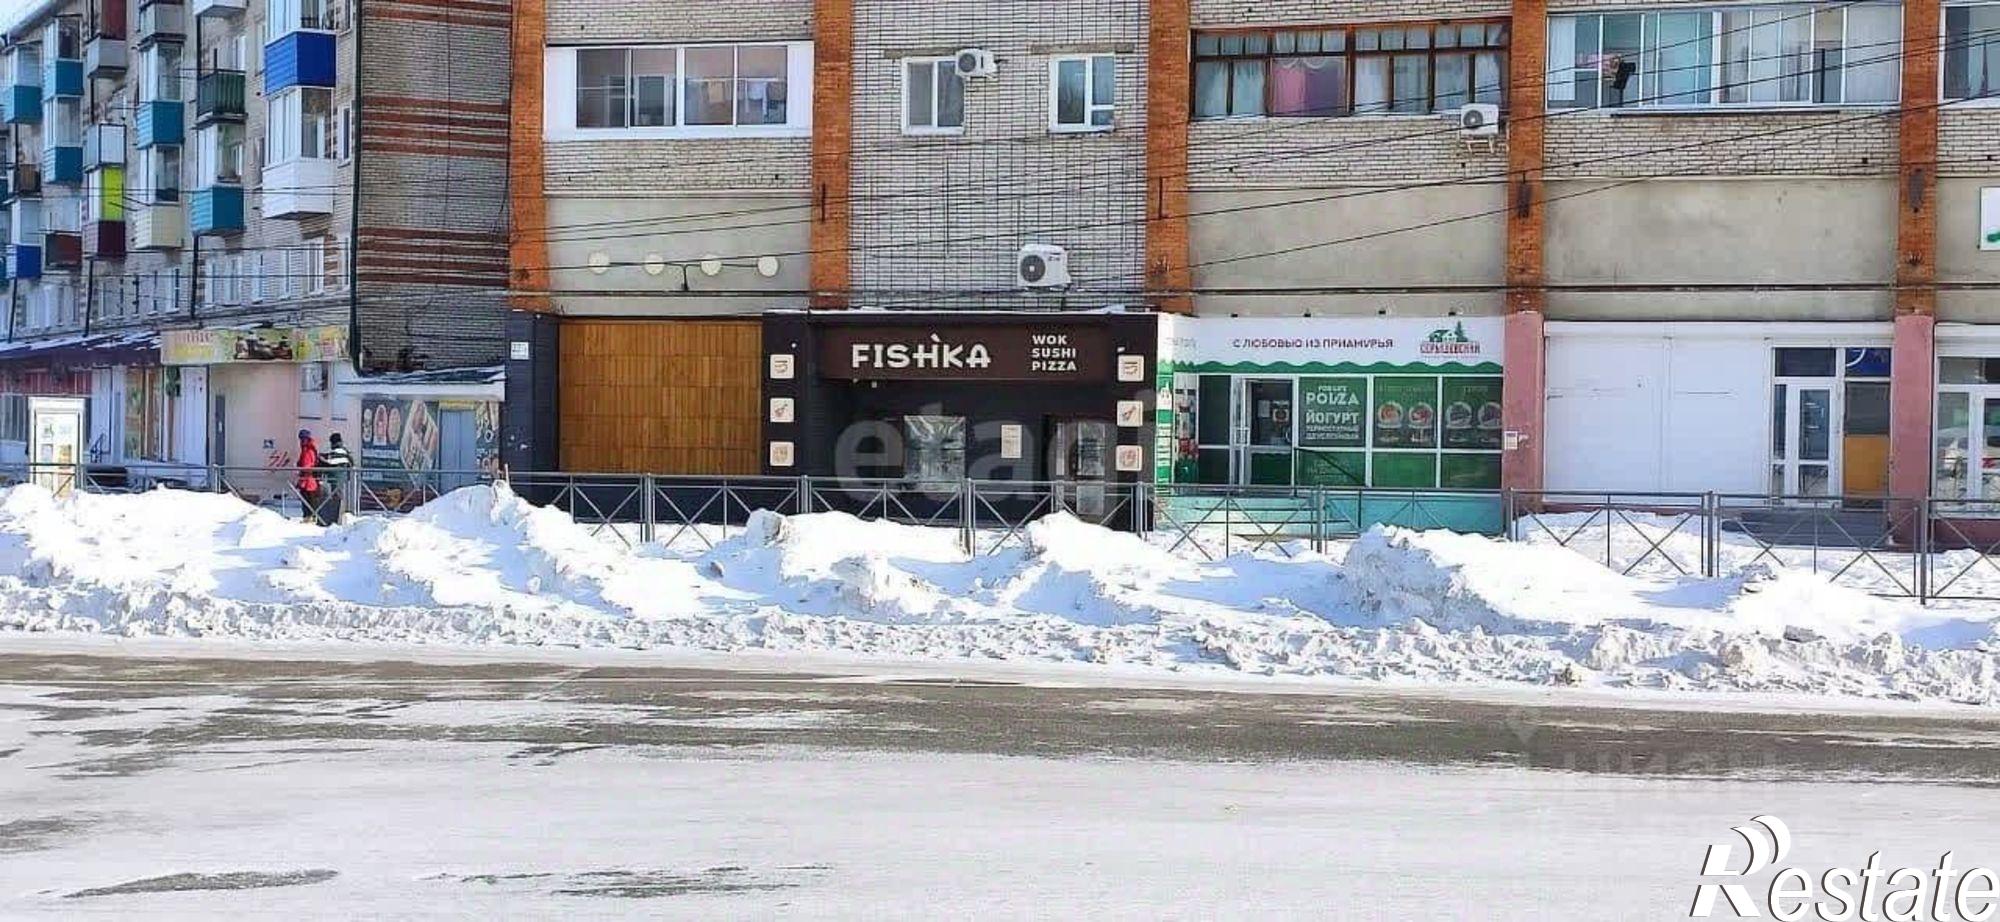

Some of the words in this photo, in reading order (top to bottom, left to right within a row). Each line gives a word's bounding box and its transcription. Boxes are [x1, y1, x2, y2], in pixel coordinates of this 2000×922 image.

[1032, 335, 1067, 345] WOK
[1232, 338, 1241, 348] С
[1243, 338, 1303, 348] ЛЮБОВЬЮ
[1305, 338, 1321, 348] ИЗ
[1323, 338, 1394, 348] ПРИАМУРЬЯ
[852, 333, 991, 368] FISHKA
[1032, 348, 1076, 358] SUSHI
[1032, 361, 1077, 371] PIZZA
[1305, 409, 1360, 424] ЙОГУРТ
